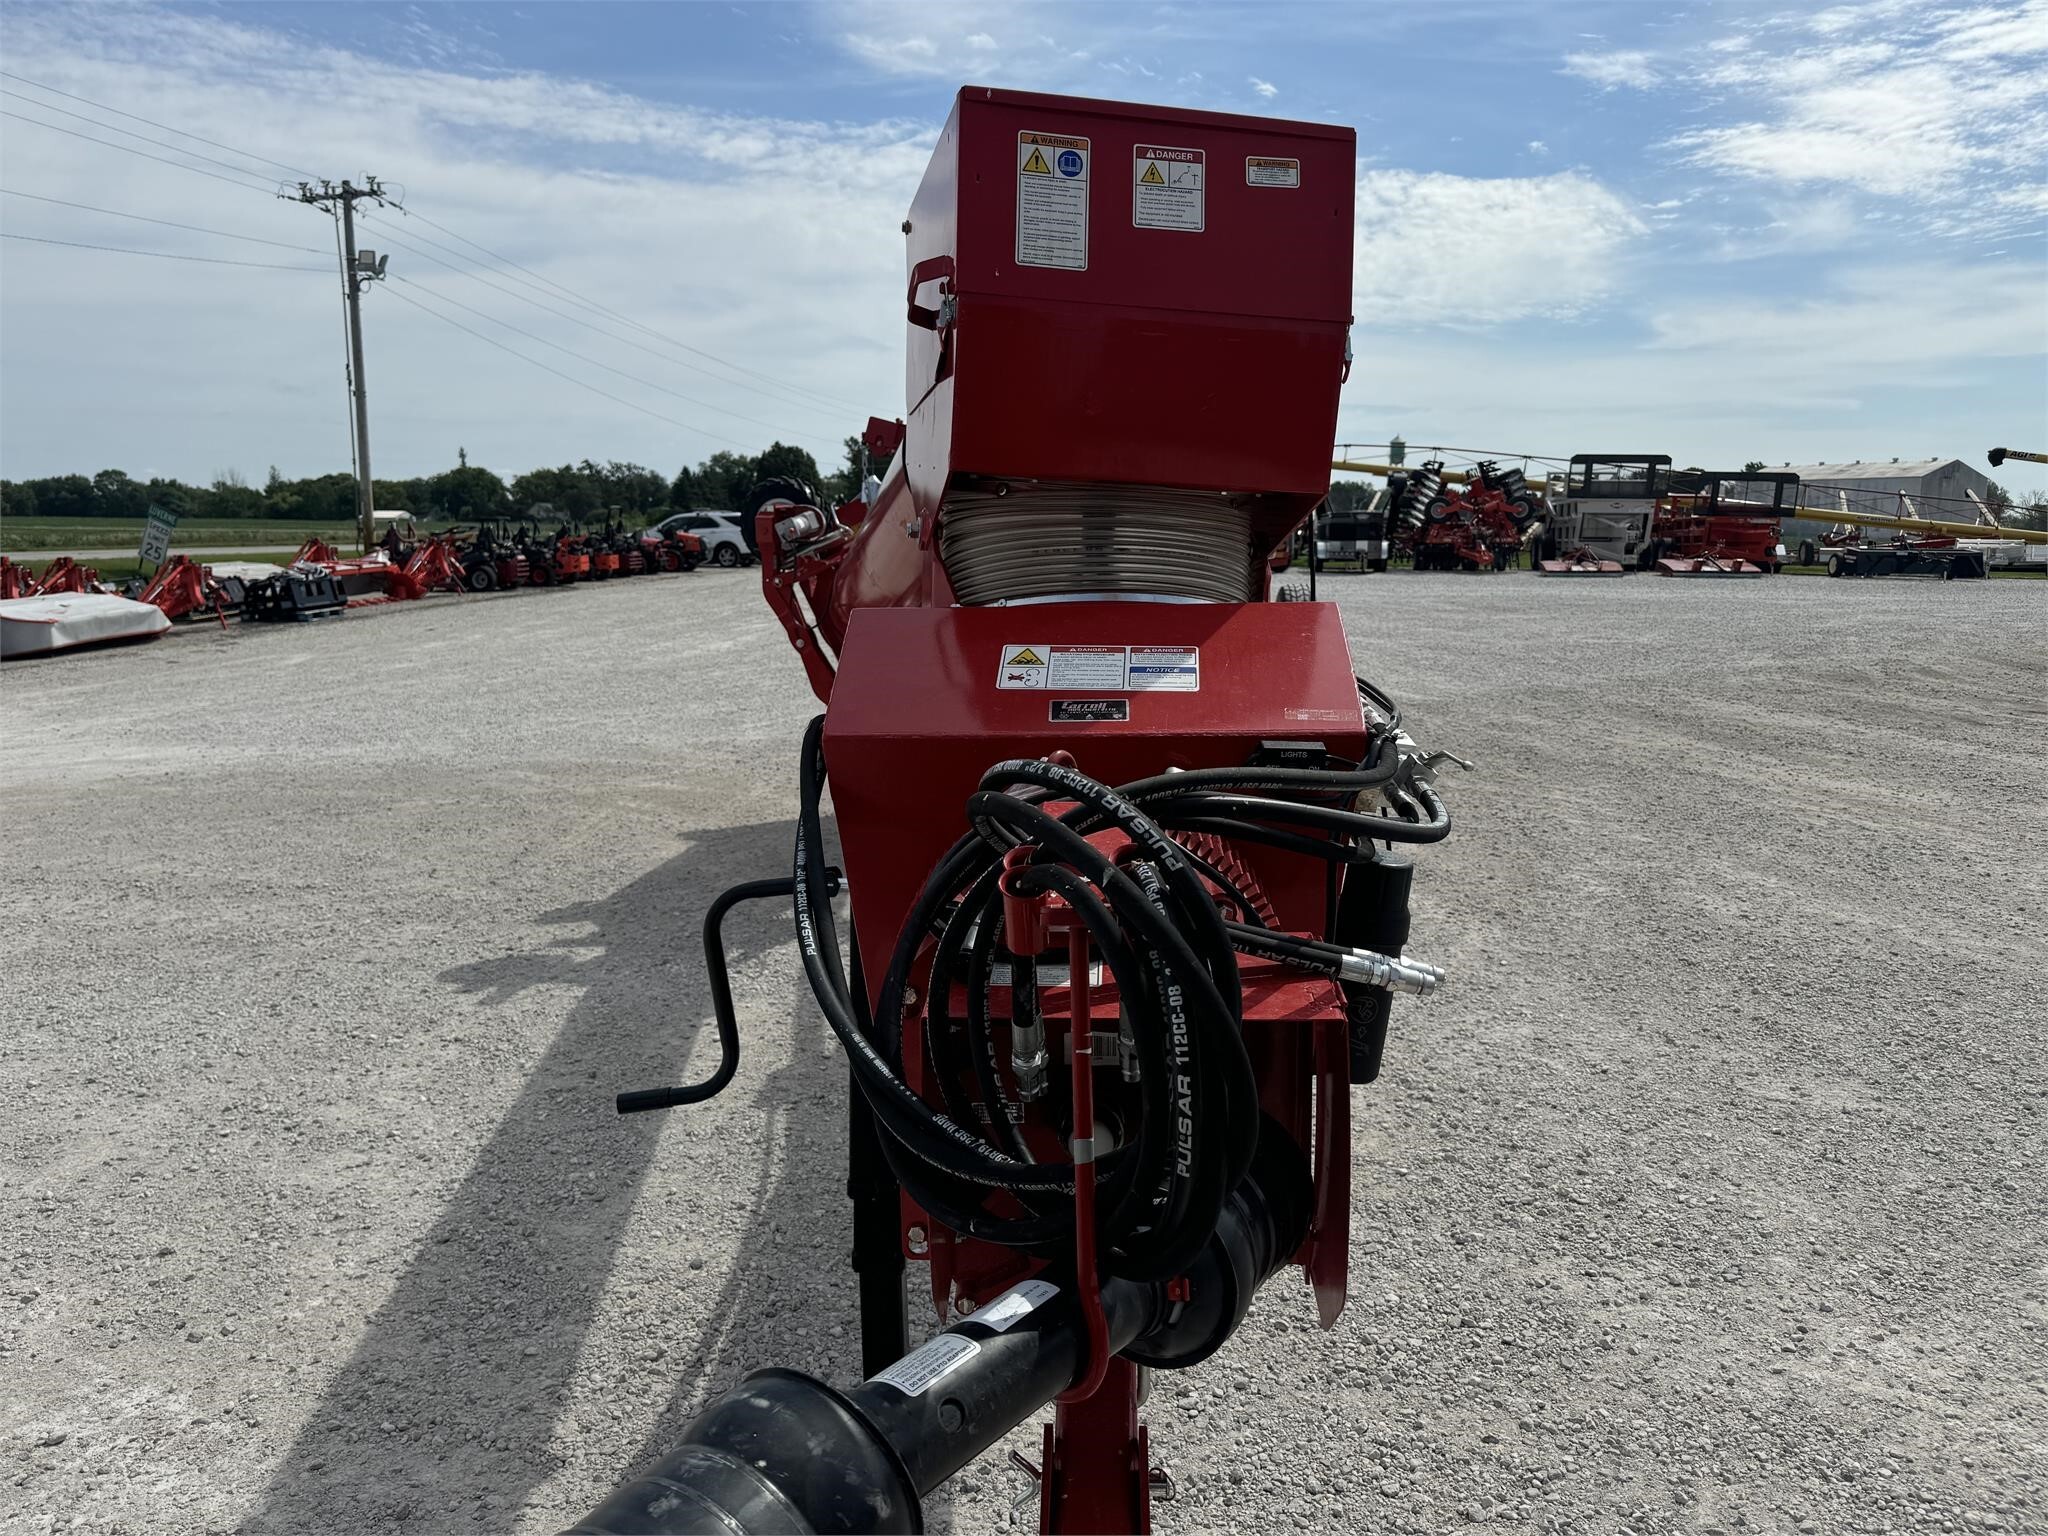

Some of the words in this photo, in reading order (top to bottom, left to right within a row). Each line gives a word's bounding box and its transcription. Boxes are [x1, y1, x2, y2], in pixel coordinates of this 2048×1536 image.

[1040, 136, 1078, 148] WARNING
[1156, 150, 1193, 160] DANGER
[144, 542, 162, 560] 25
[1048, 766, 1099, 798] 112CC-08
[1101, 794, 1184, 871] PULSAR
[797, 884, 808, 910] 112CC-08
[800, 914, 816, 956] PULSAR
[1256, 949, 1336, 975] PULSAR
[1168, 984, 1189, 1065] 112CC-08
[1176, 1076, 1193, 1178] PULSAR
[917, 1373, 928, 1384] NOT
[928, 1366, 938, 1376] USE
[938, 1360, 948, 1370] PTO
[946, 1344, 971, 1362] ADAPTORS
